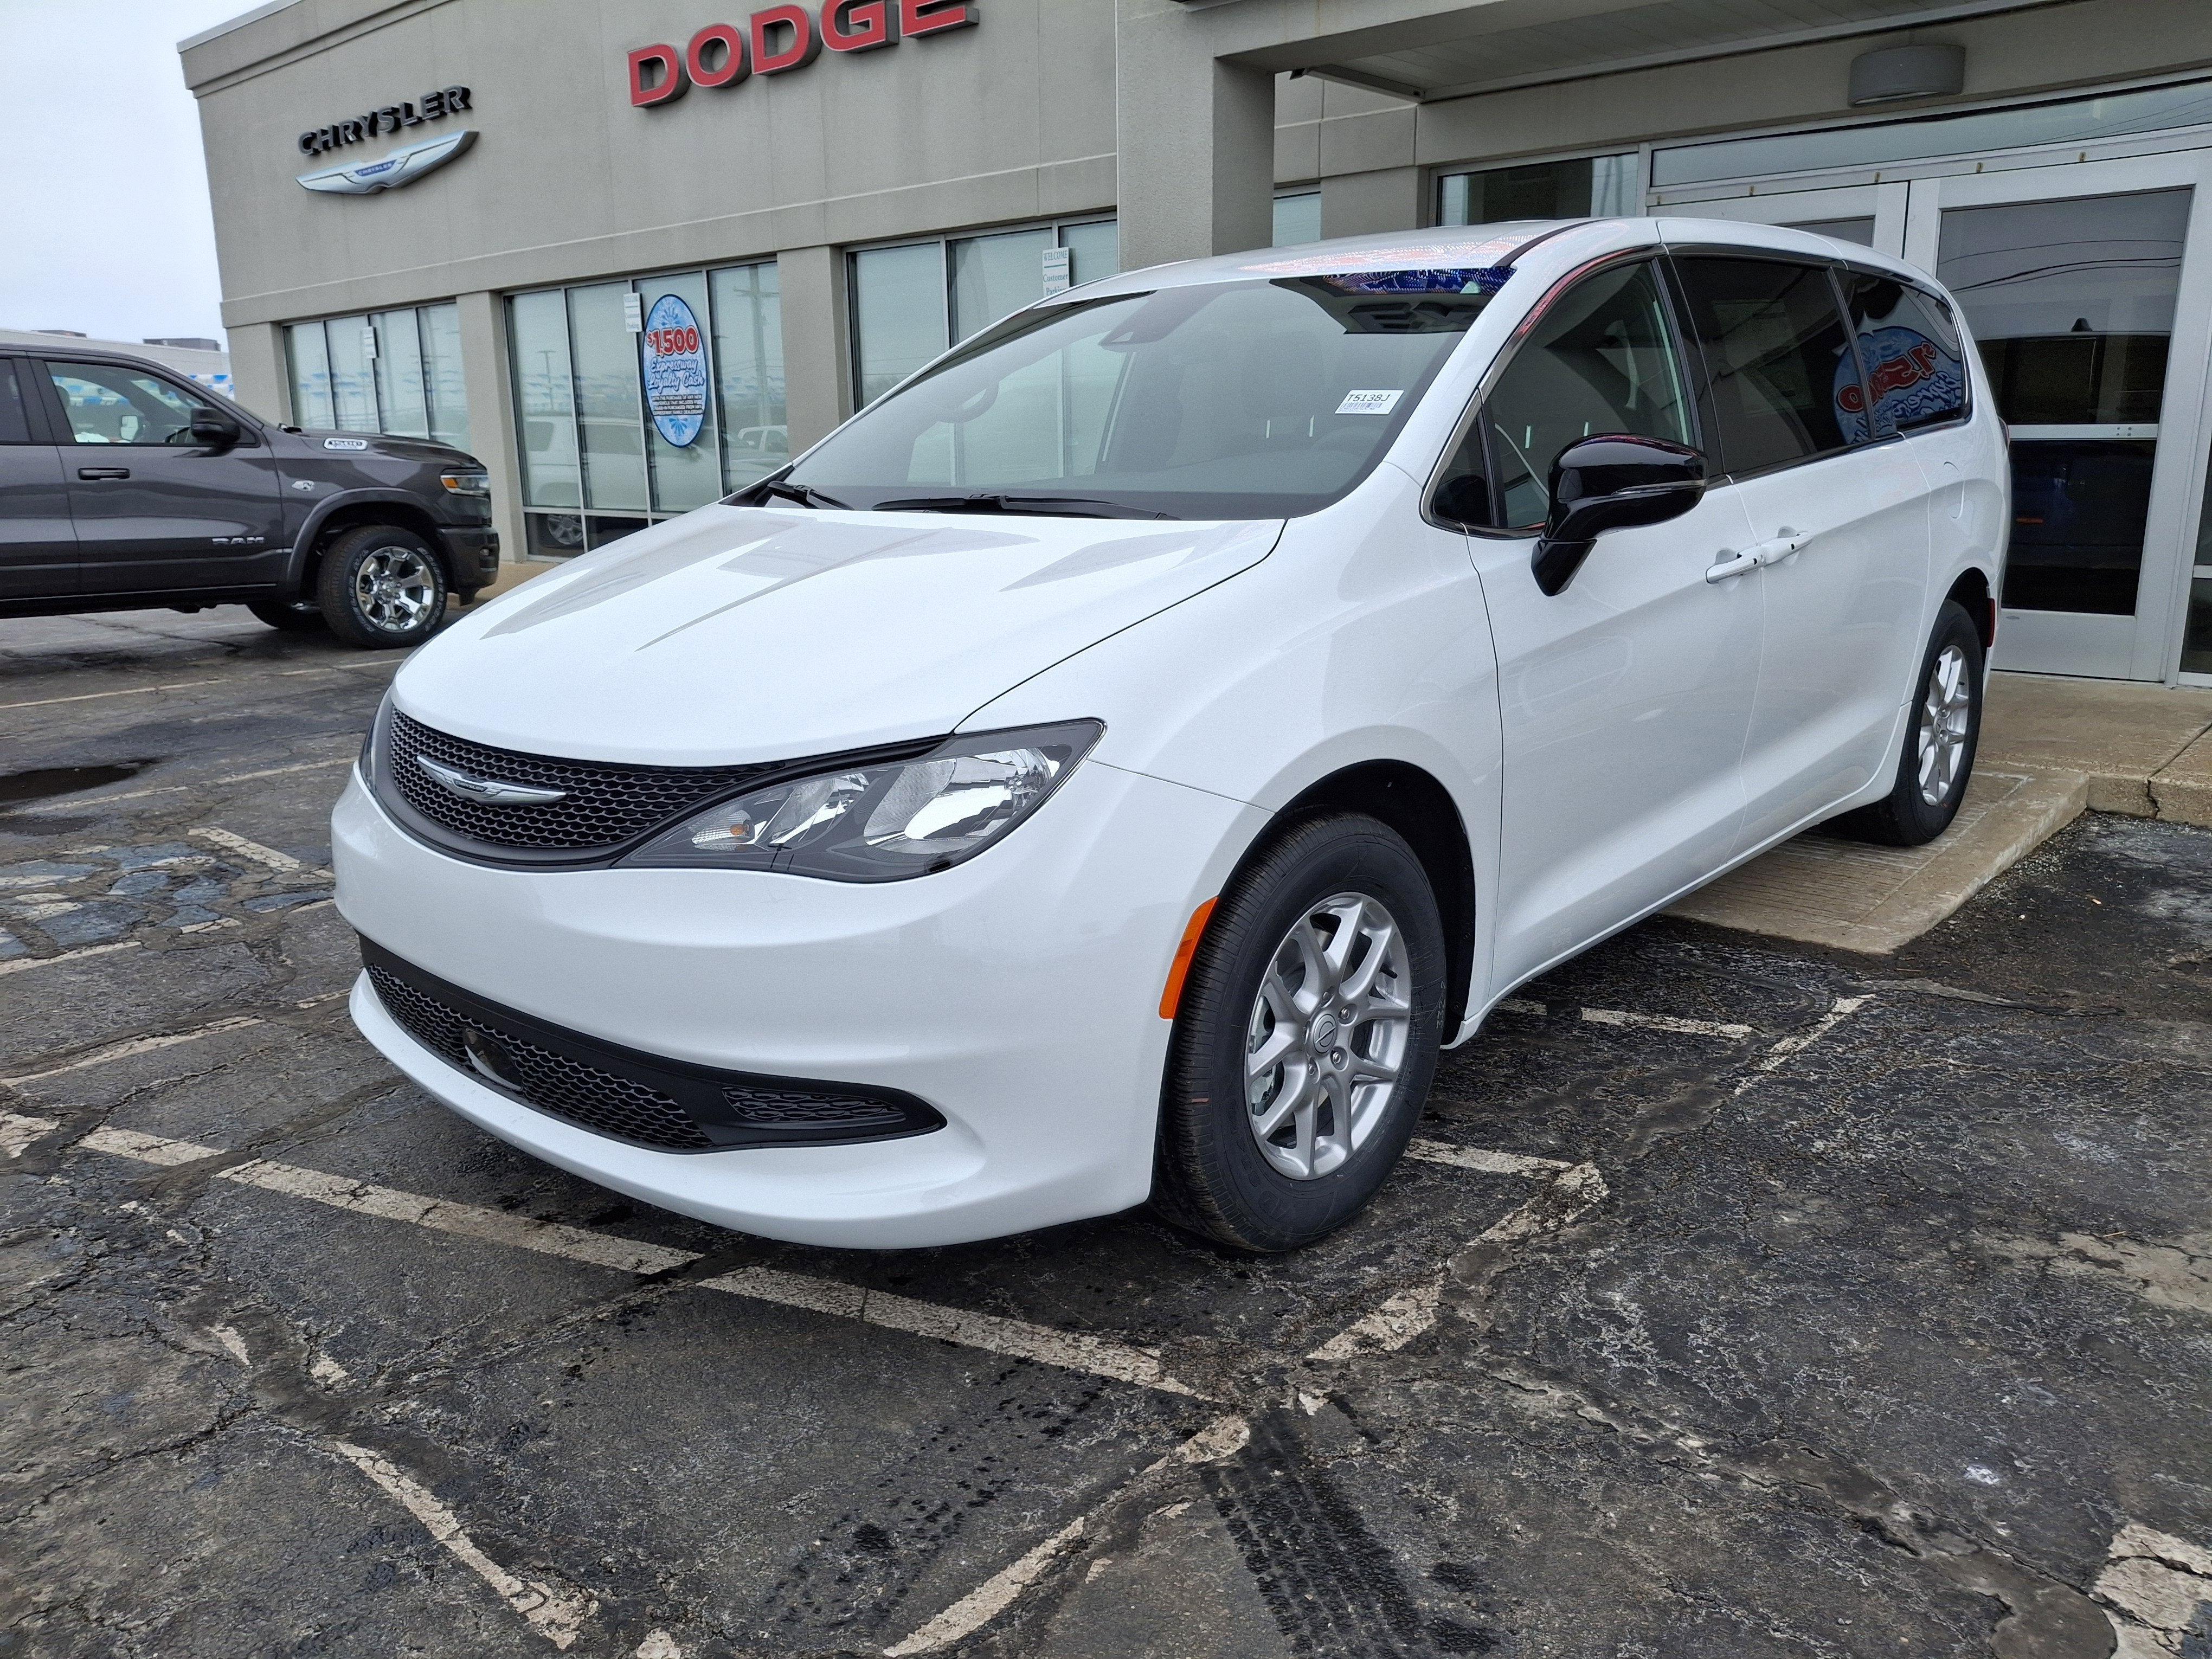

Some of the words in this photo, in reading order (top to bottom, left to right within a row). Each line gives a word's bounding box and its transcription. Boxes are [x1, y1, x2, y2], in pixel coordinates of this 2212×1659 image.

[627, 0, 979, 108] DODGE
[298, 85, 472, 156] CHRYSLER
[1043, 250, 1068, 261] WELCOME
[1043, 274, 1068, 282] Customer
[646, 325, 699, 357] $1,500
[650, 357, 698, 374] Expressway
[647, 371, 680, 394] Loyalty
[681, 370, 705, 388] Cash
[1347, 394, 1391, 402] T5138J
